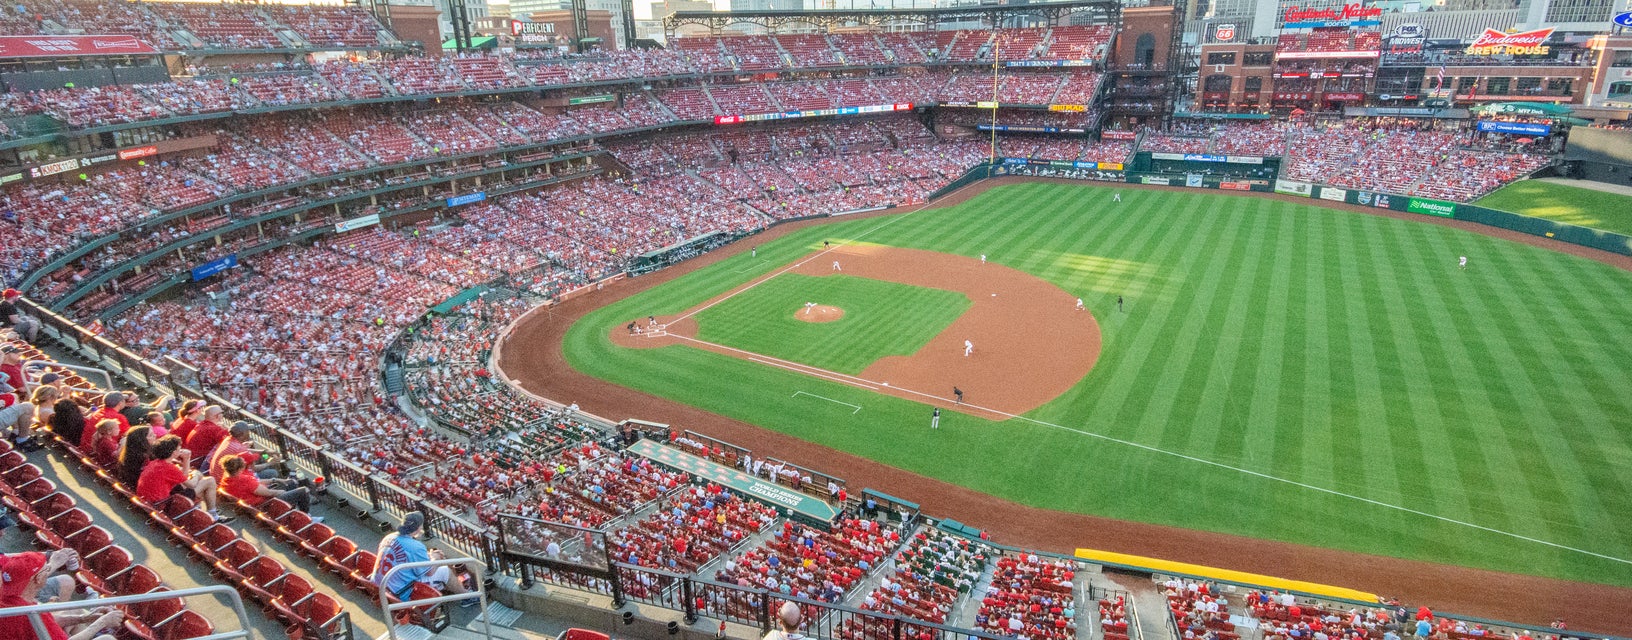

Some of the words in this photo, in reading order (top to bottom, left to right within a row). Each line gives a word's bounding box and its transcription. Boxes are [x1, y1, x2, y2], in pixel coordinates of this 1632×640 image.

[1285, 6, 1334, 22] Cardinals
[1334, 3, 1382, 20] Nation
[512, 20, 555, 35] PERFICIENT
[522, 34, 547, 42] PERCH
[1218, 30, 1231, 38] 66
[1477, 33, 1551, 45] Budweiser
[1466, 46, 1503, 55] BREW
[1505, 46, 1550, 55] HOUSE
[41, 164, 62, 176] KMOX
[1420, 202, 1453, 212] National
[754, 481, 780, 494] WORLD
[749, 485, 800, 507] CHAMPIONS
